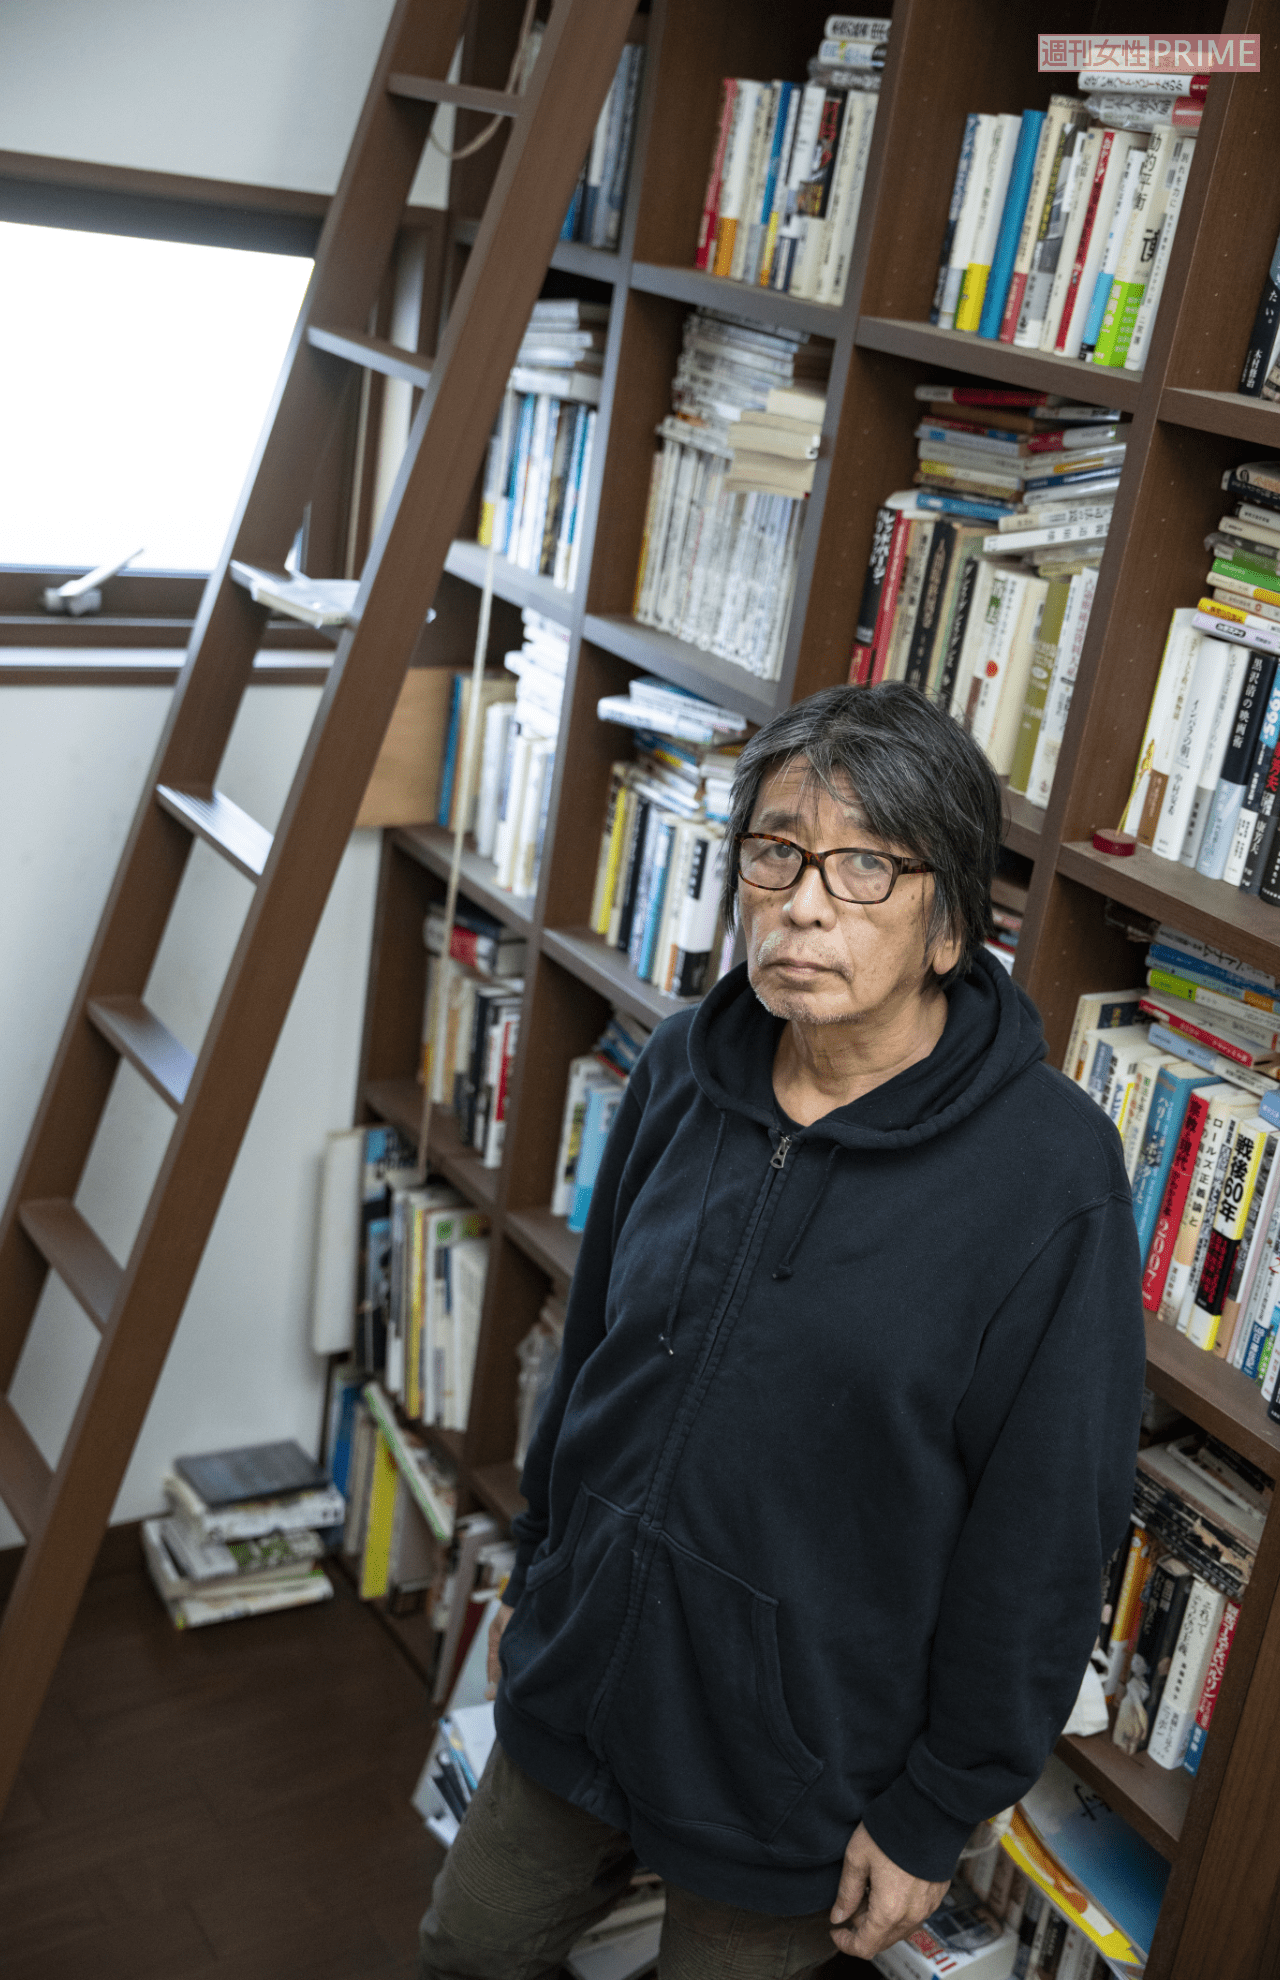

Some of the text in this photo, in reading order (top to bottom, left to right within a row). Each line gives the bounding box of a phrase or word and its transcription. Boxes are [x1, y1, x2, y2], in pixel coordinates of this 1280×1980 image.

[1232, 658, 1263, 749] 黒沢清の映画術
[1219, 1134, 1256, 1224] 戦後60年
